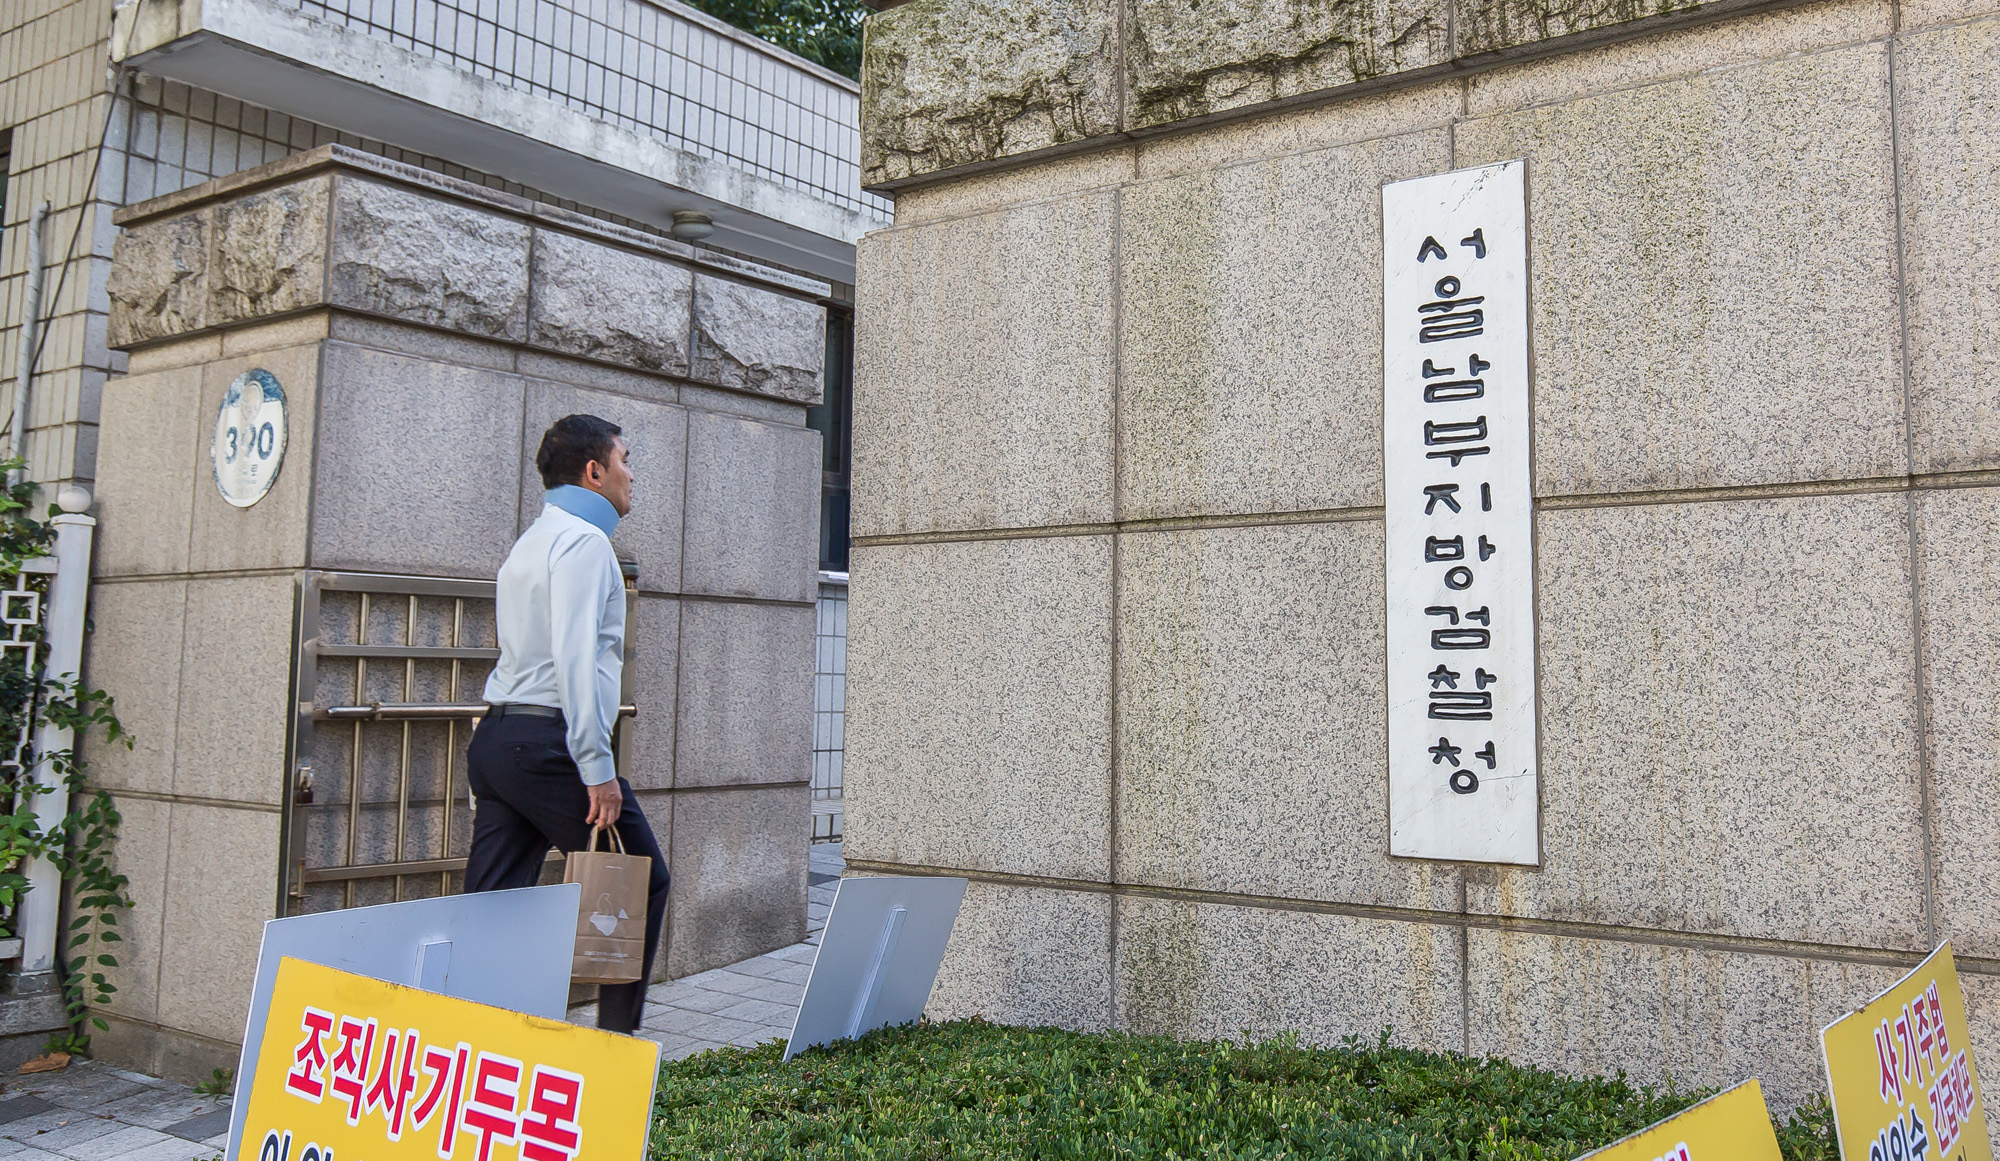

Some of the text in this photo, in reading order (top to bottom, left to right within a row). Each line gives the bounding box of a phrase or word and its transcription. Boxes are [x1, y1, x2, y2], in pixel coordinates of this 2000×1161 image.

[1416, 227, 1498, 795] 서울남부지방검찰청
[287, 1010, 583, 1161] 조직사기두목
[1875, 982, 1950, 1103] 사기주범
